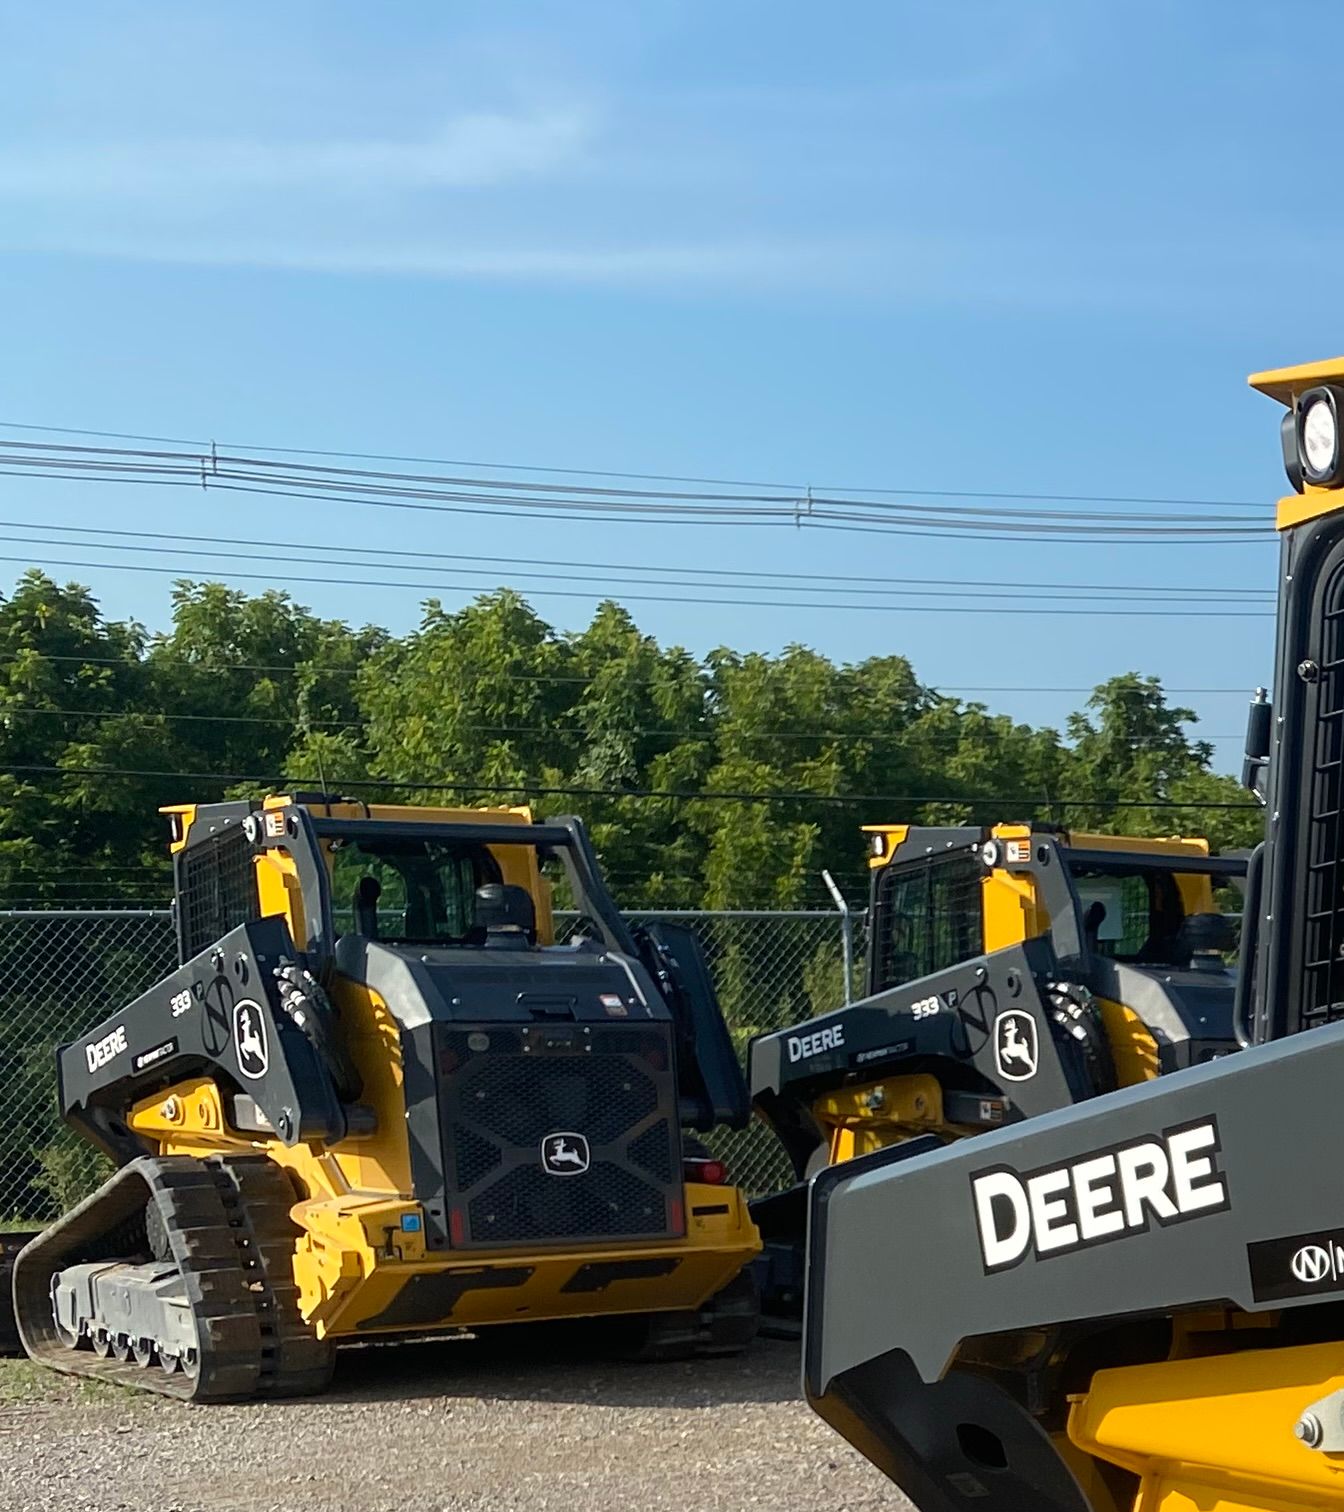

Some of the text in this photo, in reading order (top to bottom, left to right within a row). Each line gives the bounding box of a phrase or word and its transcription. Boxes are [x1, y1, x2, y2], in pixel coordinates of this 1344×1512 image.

[85, 1024, 129, 1074] DEERE
[787, 1024, 846, 1063] DEERE
[972, 1124, 1225, 1267] DEERE
